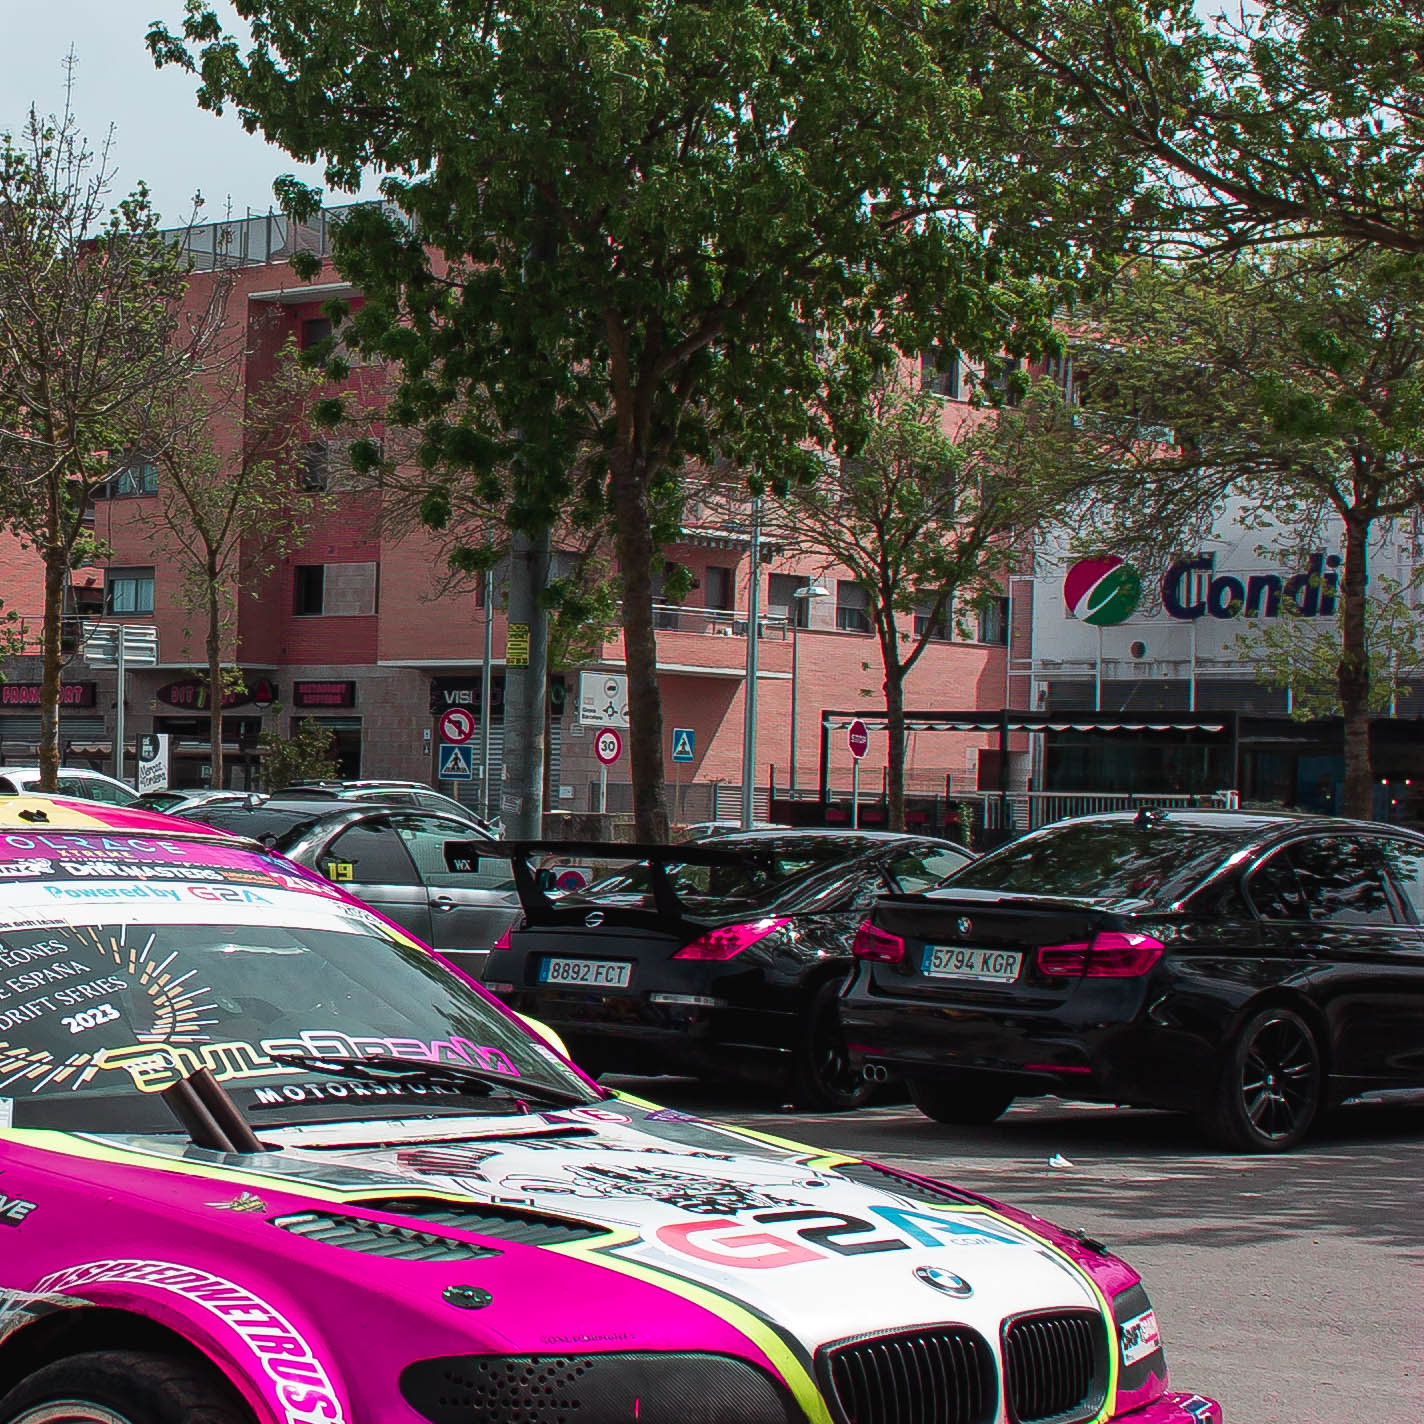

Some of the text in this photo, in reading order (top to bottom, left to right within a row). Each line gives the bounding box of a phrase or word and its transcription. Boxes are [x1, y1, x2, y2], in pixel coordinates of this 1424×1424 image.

[1160, 550, 1344, 620] Condi
[600, 740, 616, 753] 30
[851, 734, 867, 744] STOP
[327, 862, 354, 881] 19
[43, 884, 274, 905] Powered by G2A
[550, 962, 591, 982] 8892
[932, 949, 1017, 975] 5794 KGR
[6, 959, 92, 993] ESPAÑA
[56, 974, 129, 1007] SERIES
[60, 1002, 122, 1035] 2023
[656, 1205, 1022, 1270] G2A
